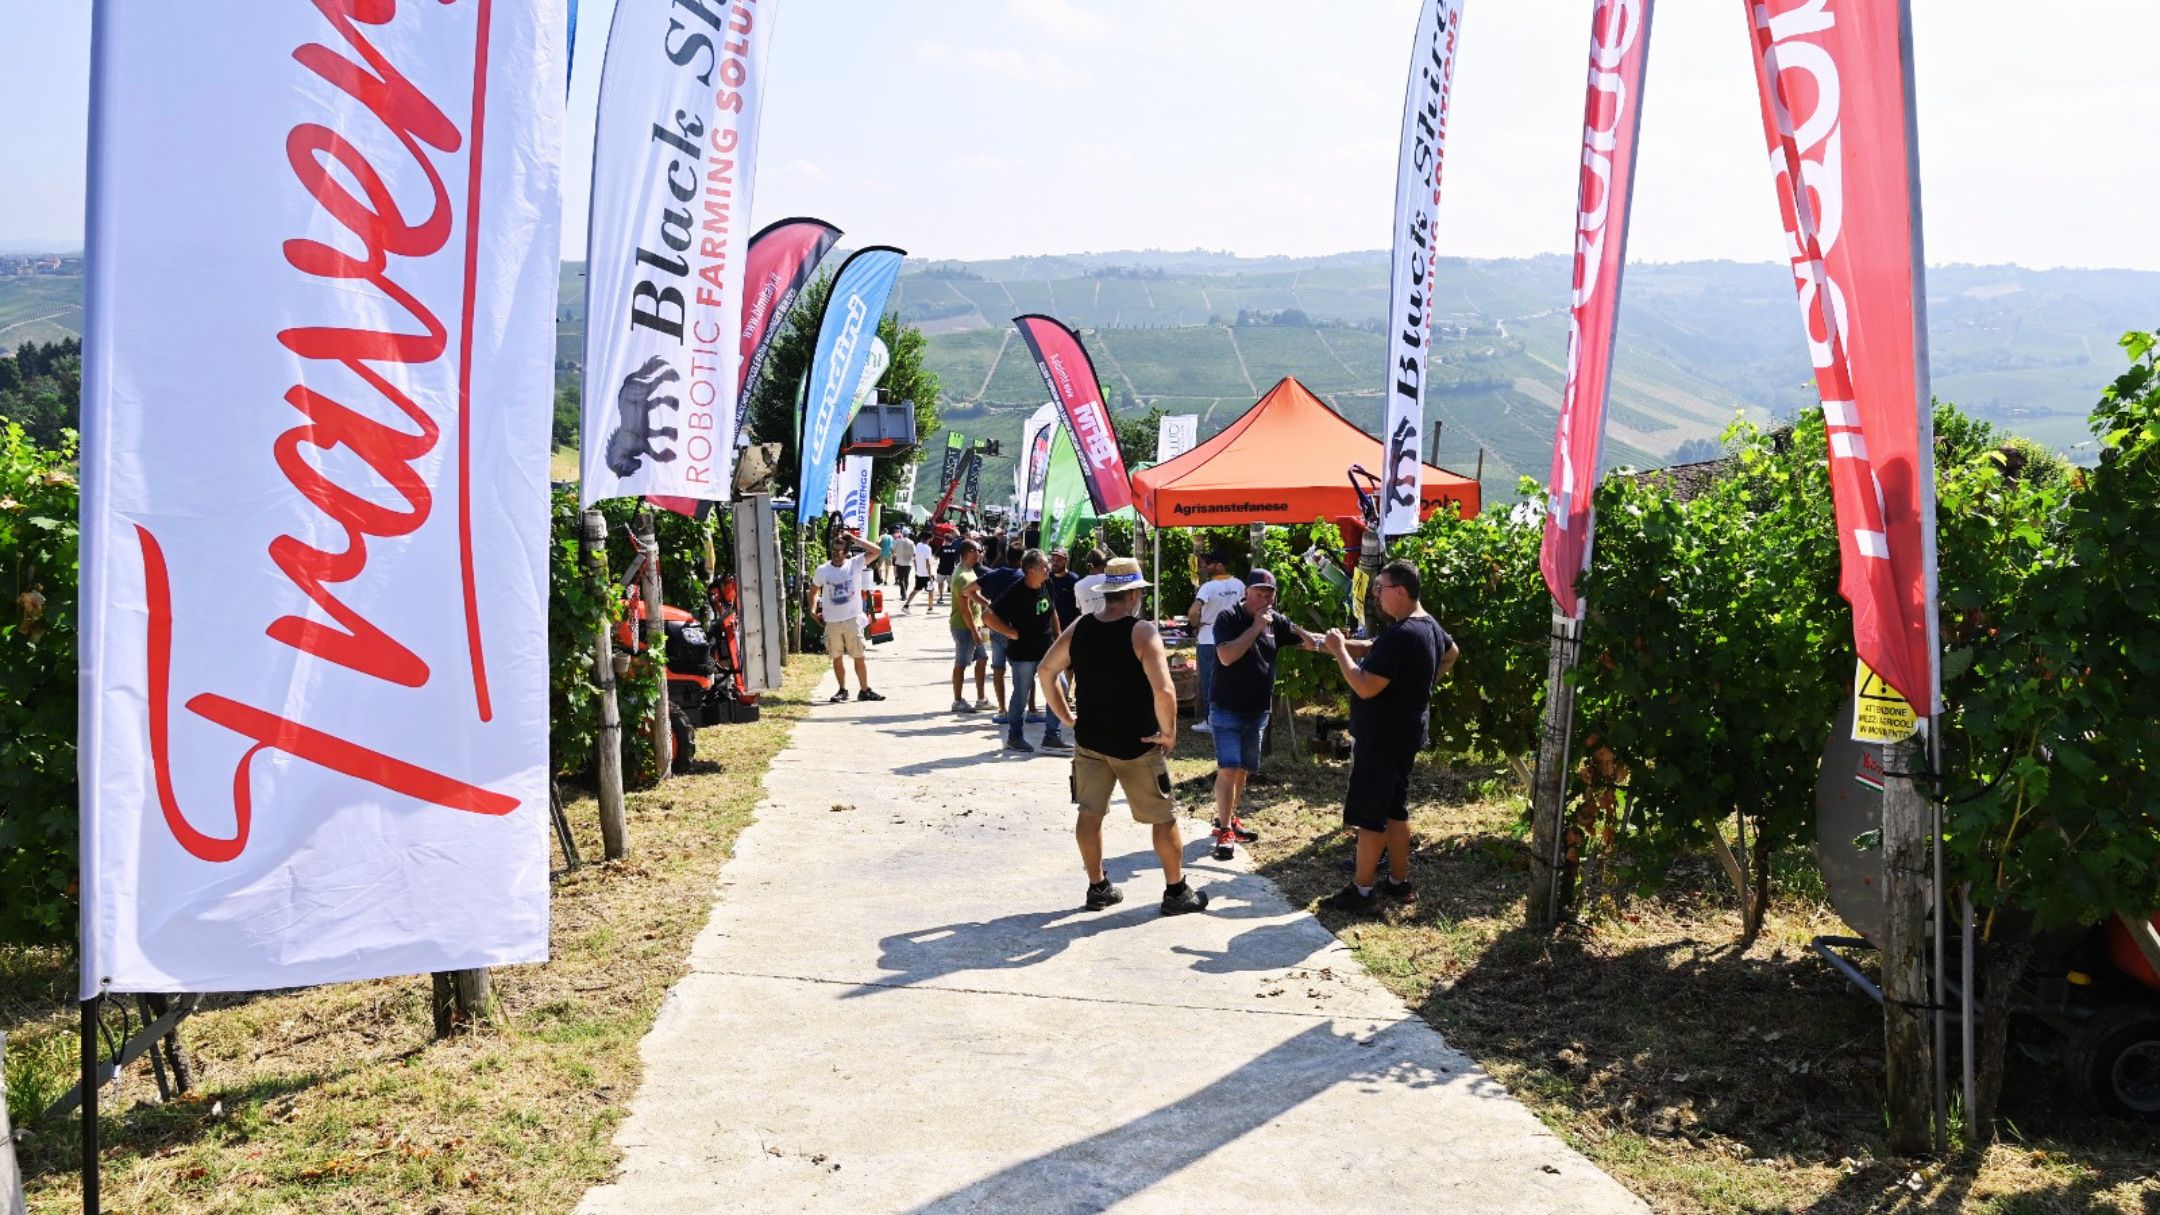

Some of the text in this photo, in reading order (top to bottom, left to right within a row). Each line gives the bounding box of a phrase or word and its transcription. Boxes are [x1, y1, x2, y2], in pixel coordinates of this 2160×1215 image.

[631, 108, 705, 347] Black
[686, 0, 757, 485] ROBOTIC FARMING SOLU
[1397, 0, 1448, 407] Black Shire
[133, 0, 521, 863] Traver
[1174, 501, 1289, 515] Agrisanstefanese
[1865, 704, 1908, 717] ATTENZIONE
